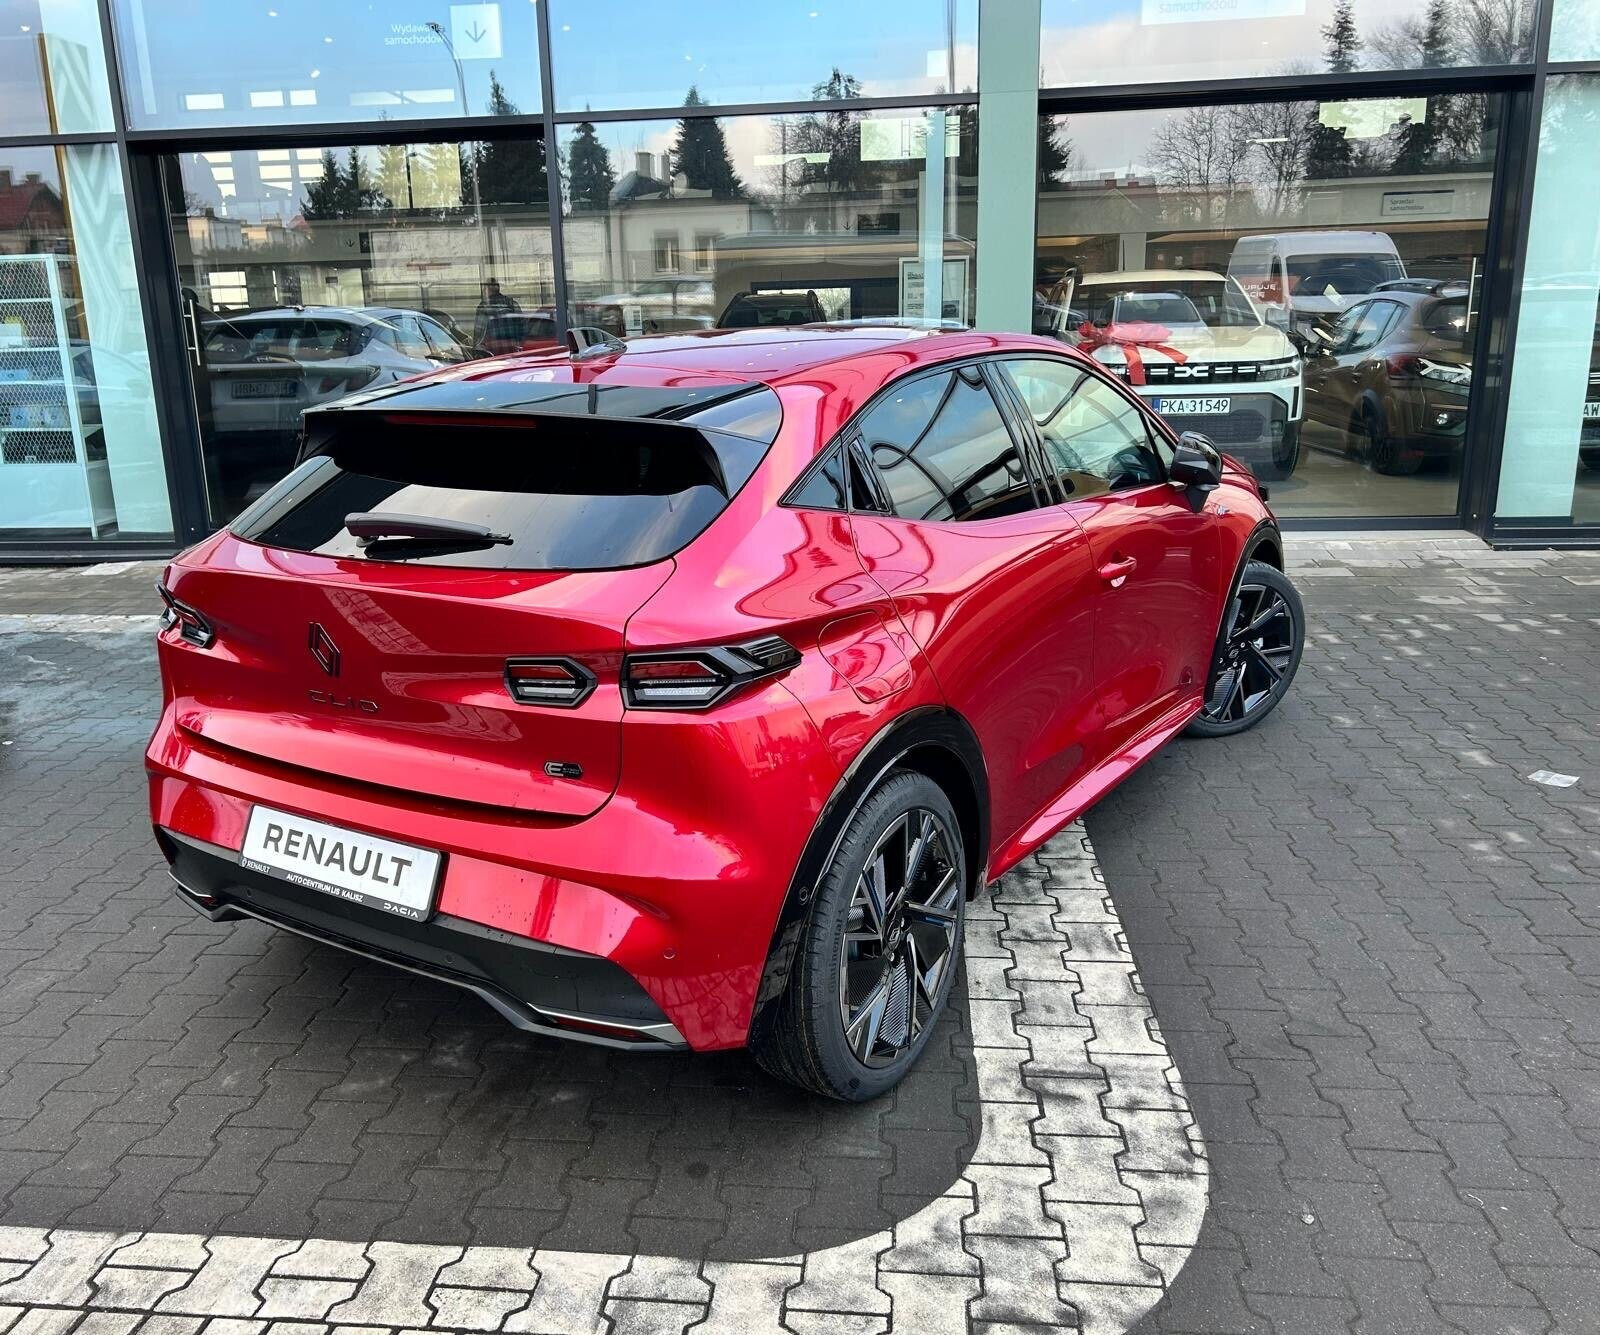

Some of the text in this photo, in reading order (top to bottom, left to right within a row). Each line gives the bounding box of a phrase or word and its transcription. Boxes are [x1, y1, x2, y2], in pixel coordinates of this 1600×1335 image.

[1242, 283, 1277, 291] UPUJĘ
[1160, 399, 1229, 413] PKA 31549
[308, 689, 379, 713] CLIO
[262, 822, 413, 887] RENAULT
[247, 861, 271, 874] RENAULT
[286, 873, 364, 903] AUTO CENTRUM LIS KALISZ
[383, 902, 419, 918] DACIA
